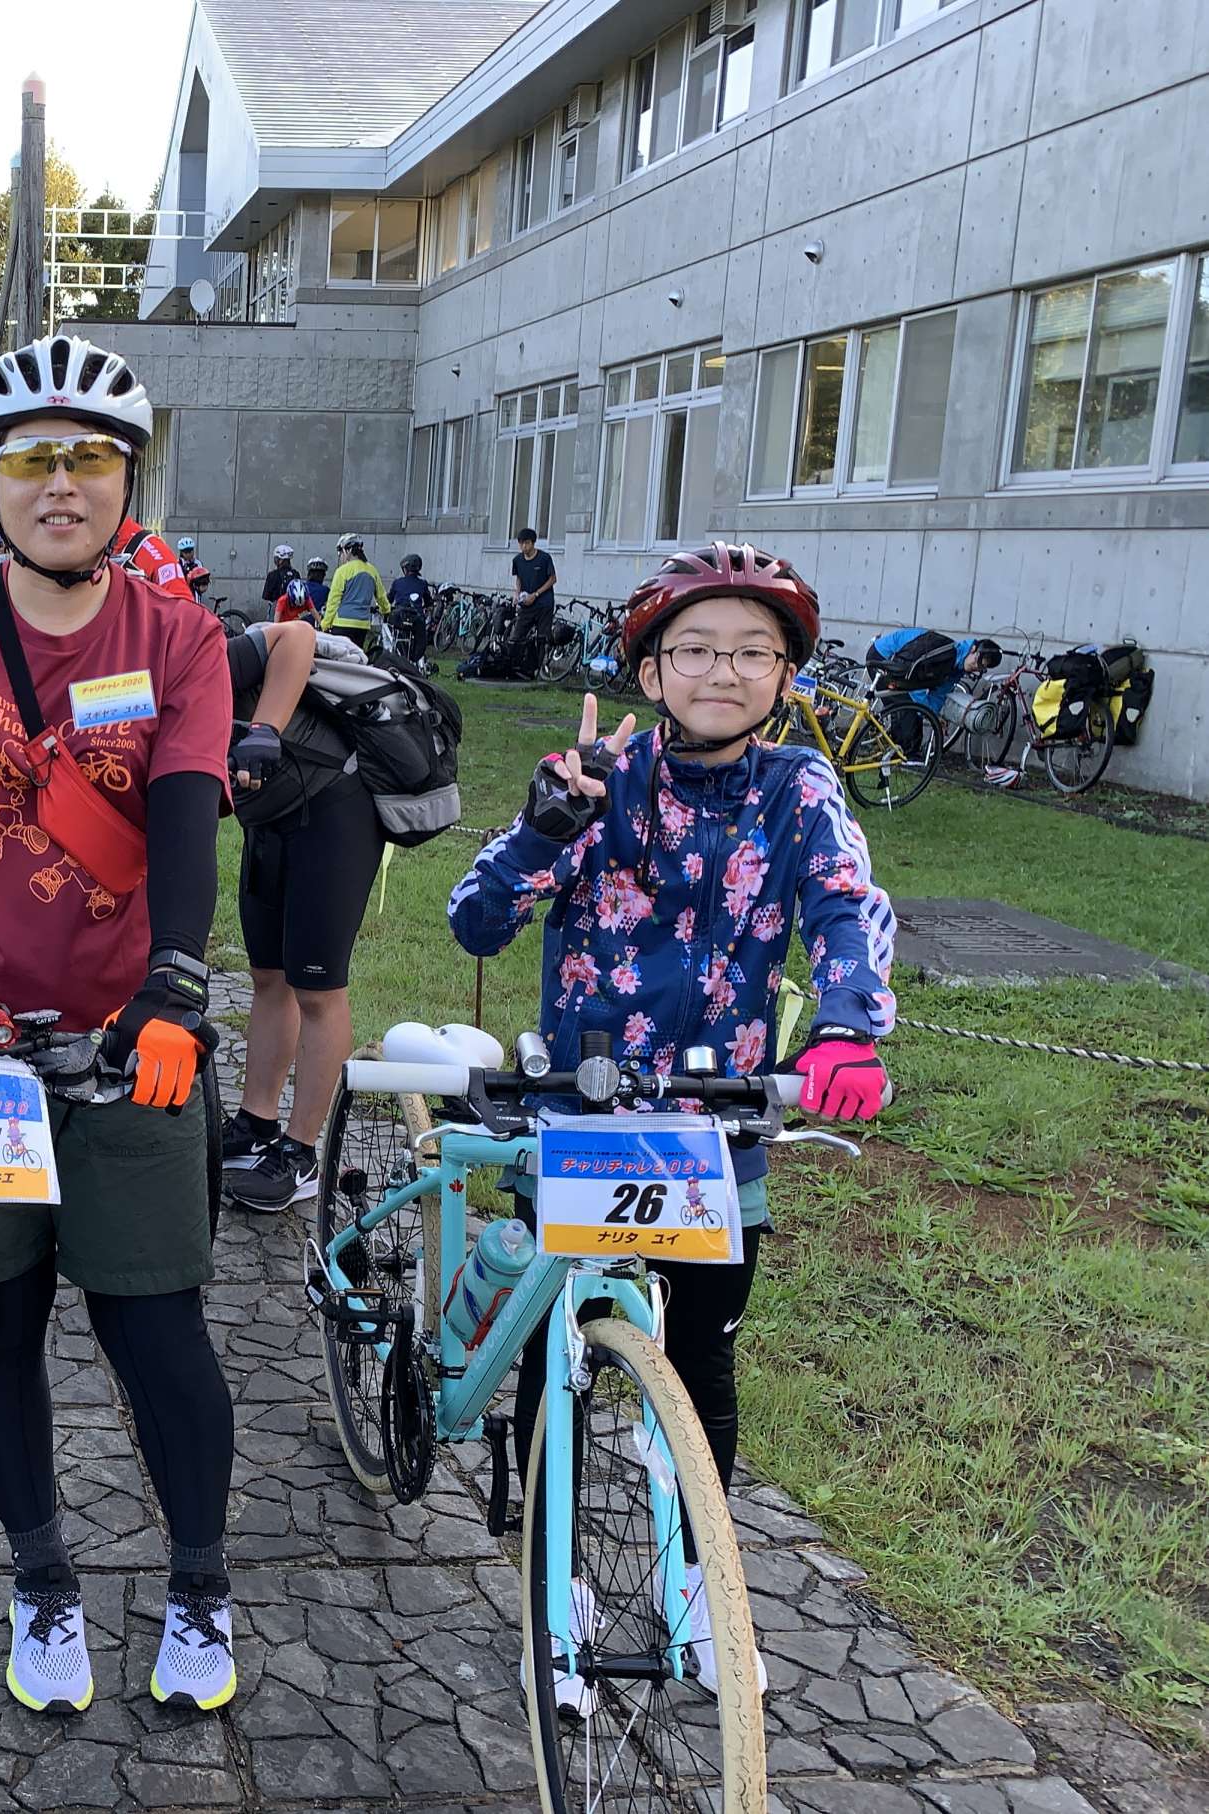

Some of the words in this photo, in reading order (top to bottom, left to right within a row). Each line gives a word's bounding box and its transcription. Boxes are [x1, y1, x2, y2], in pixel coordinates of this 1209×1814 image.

[604, 1183, 668, 1225] 26
[597, 1231, 639, 1244] ナリタ
[651, 1232, 680, 1246] ユイ
